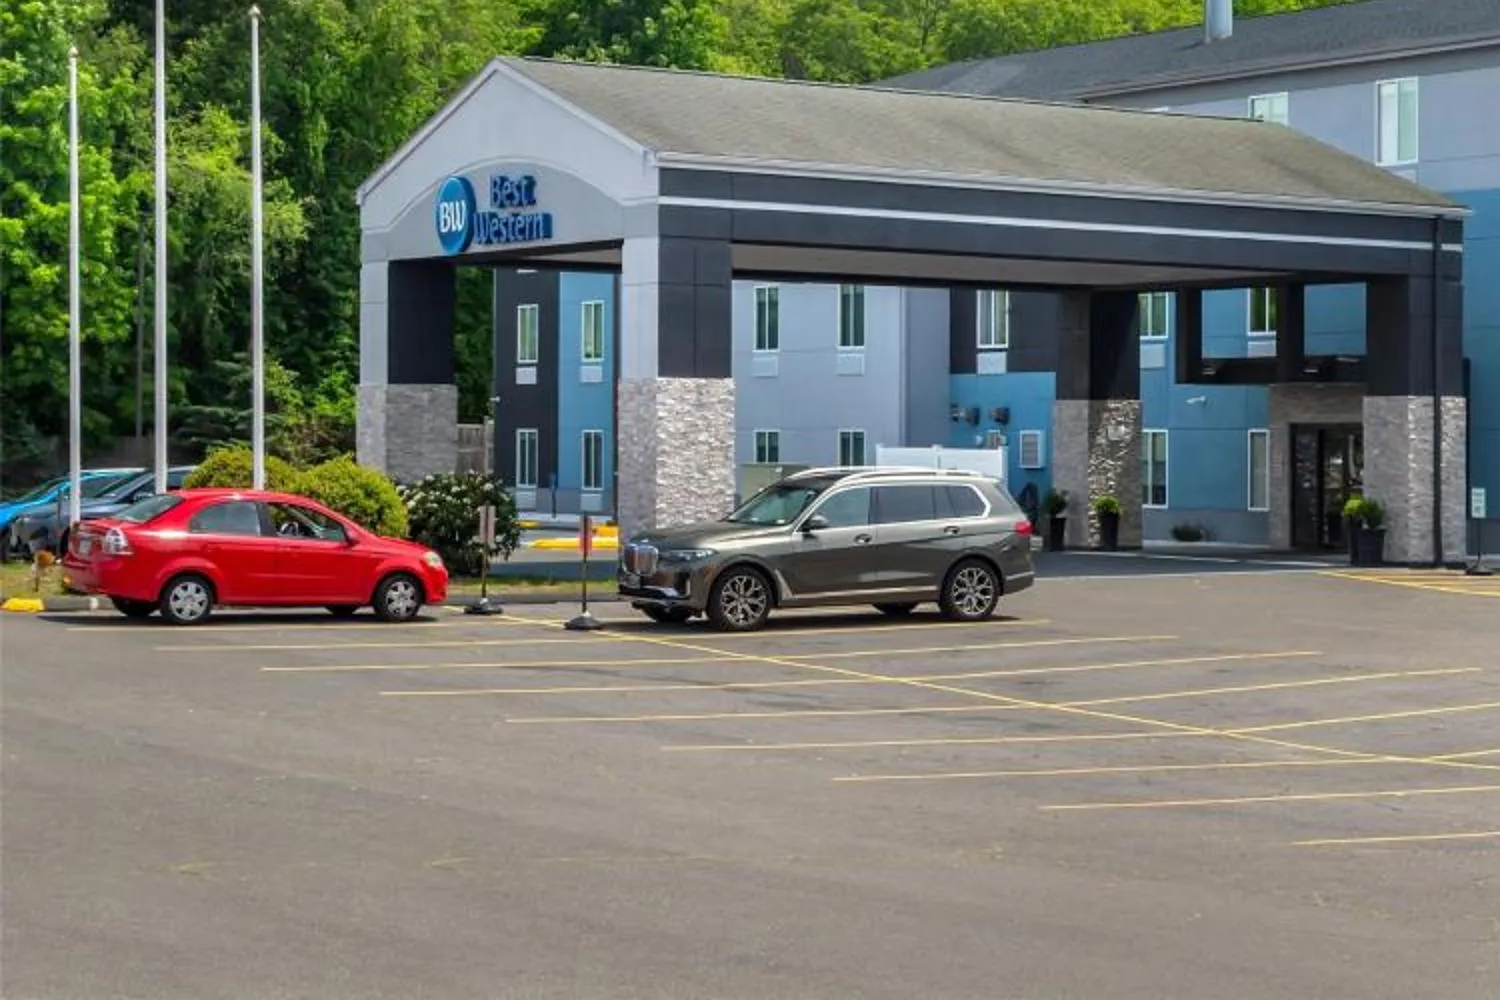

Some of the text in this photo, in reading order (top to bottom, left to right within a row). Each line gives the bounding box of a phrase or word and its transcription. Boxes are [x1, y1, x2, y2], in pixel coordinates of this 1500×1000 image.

[490, 175, 534, 207] Best
[439, 200, 466, 233] BW
[473, 211, 547, 244] Western
